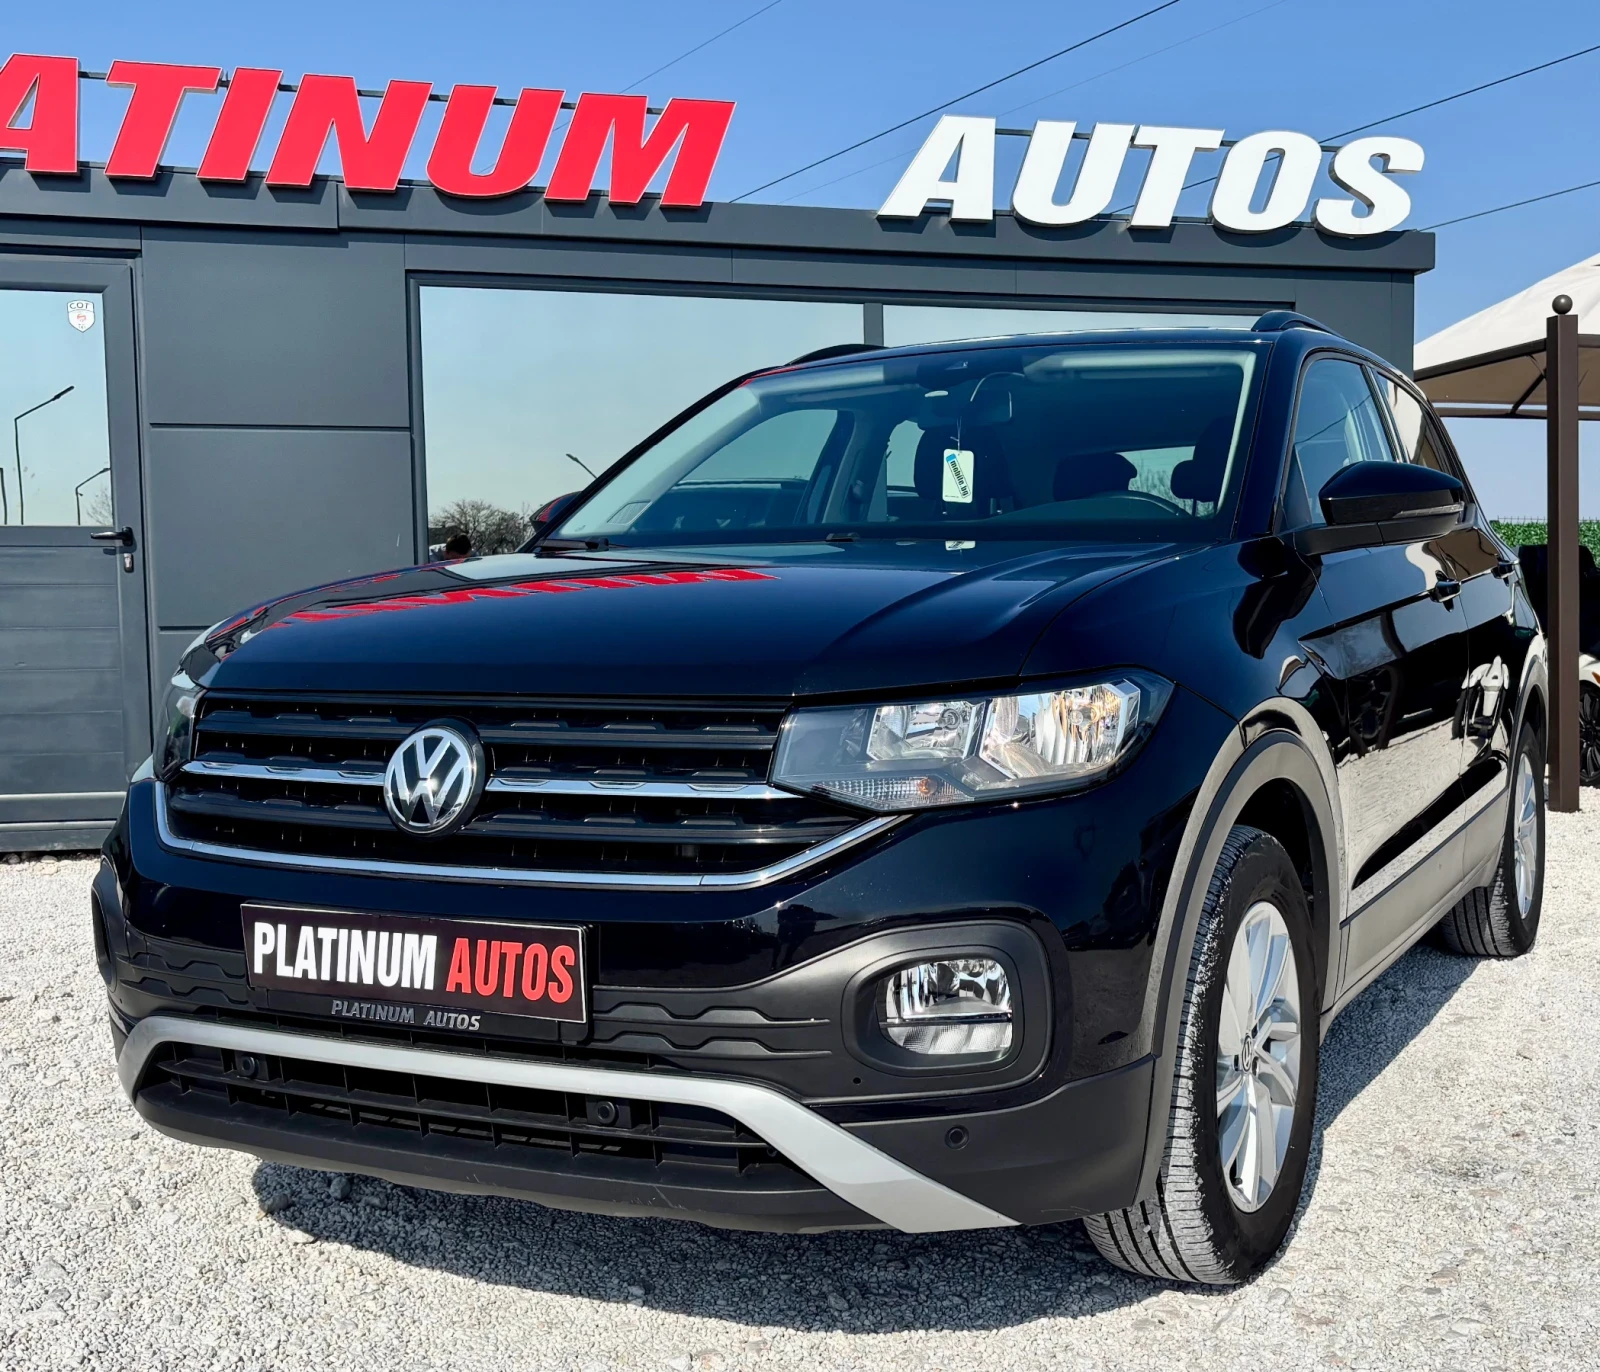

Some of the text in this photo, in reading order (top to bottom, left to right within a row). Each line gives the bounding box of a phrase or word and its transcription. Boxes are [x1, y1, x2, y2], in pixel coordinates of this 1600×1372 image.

[876, 114, 1426, 237] AUTOS
[950, 460, 969, 496] mobile.bg
[253, 921, 576, 1004] PLATINUM AUTOS
[330, 999, 482, 1032] PLATINUM AUTOS
